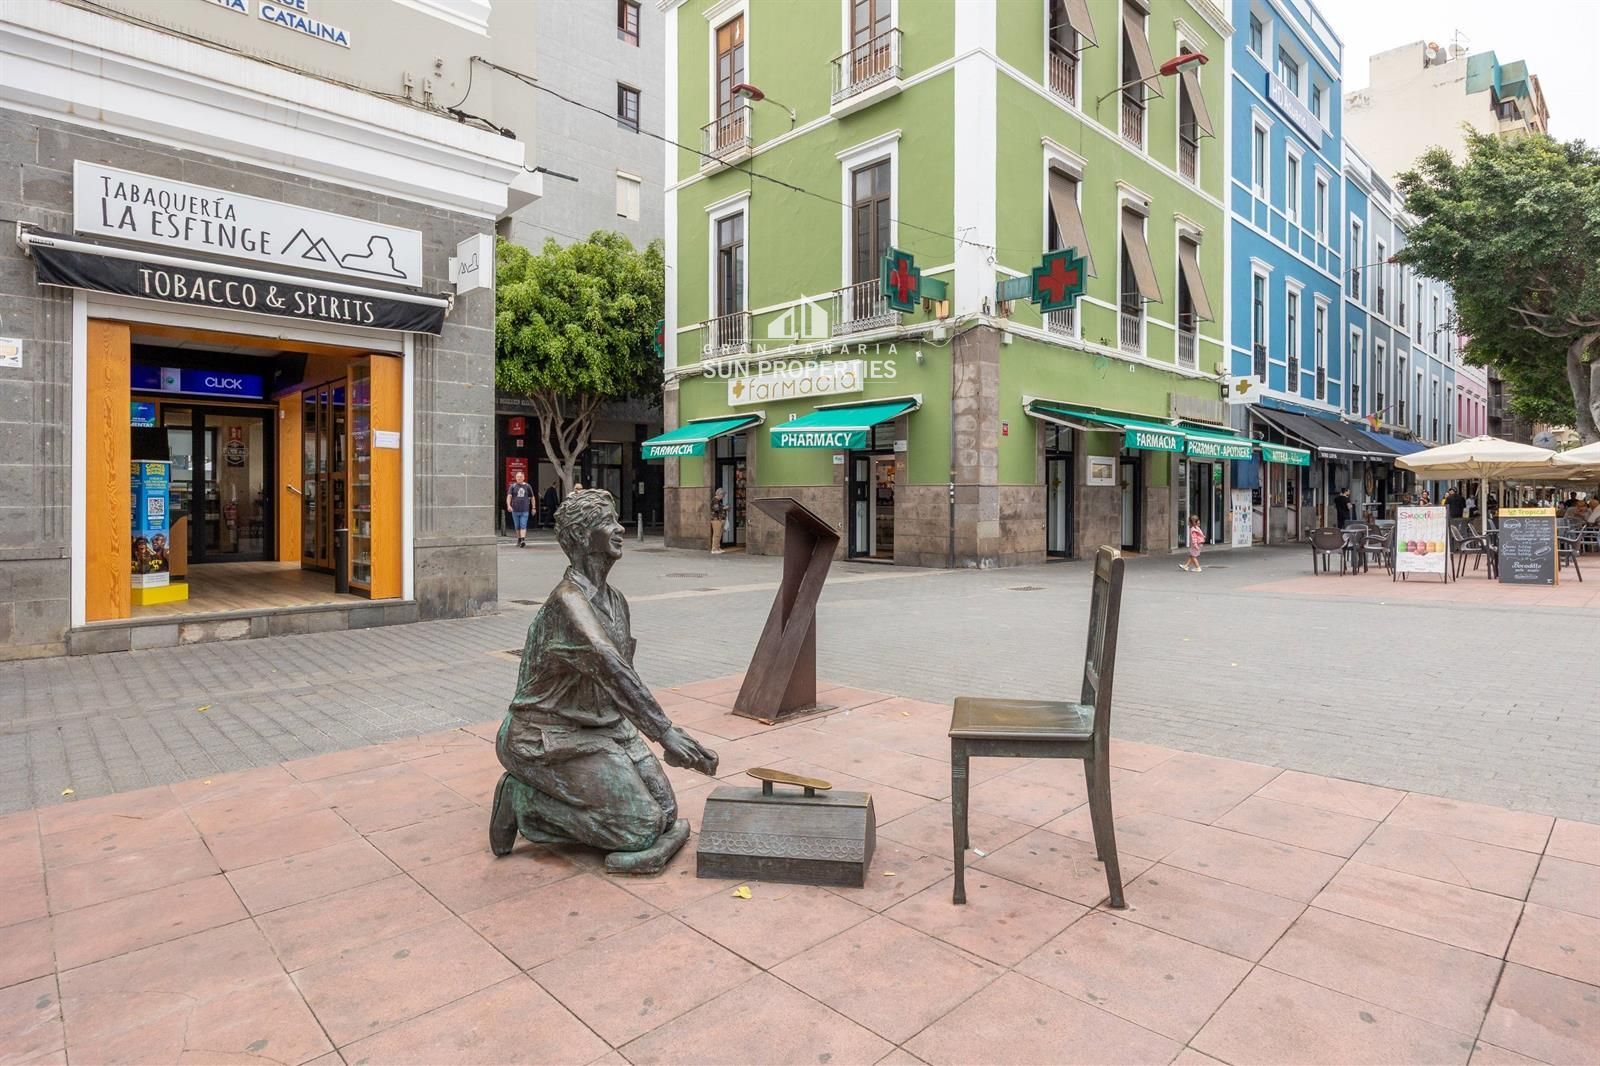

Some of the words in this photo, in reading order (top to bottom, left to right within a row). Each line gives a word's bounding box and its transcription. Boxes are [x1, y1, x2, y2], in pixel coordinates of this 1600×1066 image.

[261, 5, 348, 46] CATALINA
[100, 176, 237, 222] TABAQUERÍA
[101, 197, 137, 232] LA
[151, 210, 272, 255] ESFINGE
[139, 268, 256, 307] TOBACCO
[266, 285, 286, 309] &
[294, 291, 374, 324] SPIRITS
[204, 376, 243, 390] CLICK
[781, 432, 853, 447] PHARMACY
